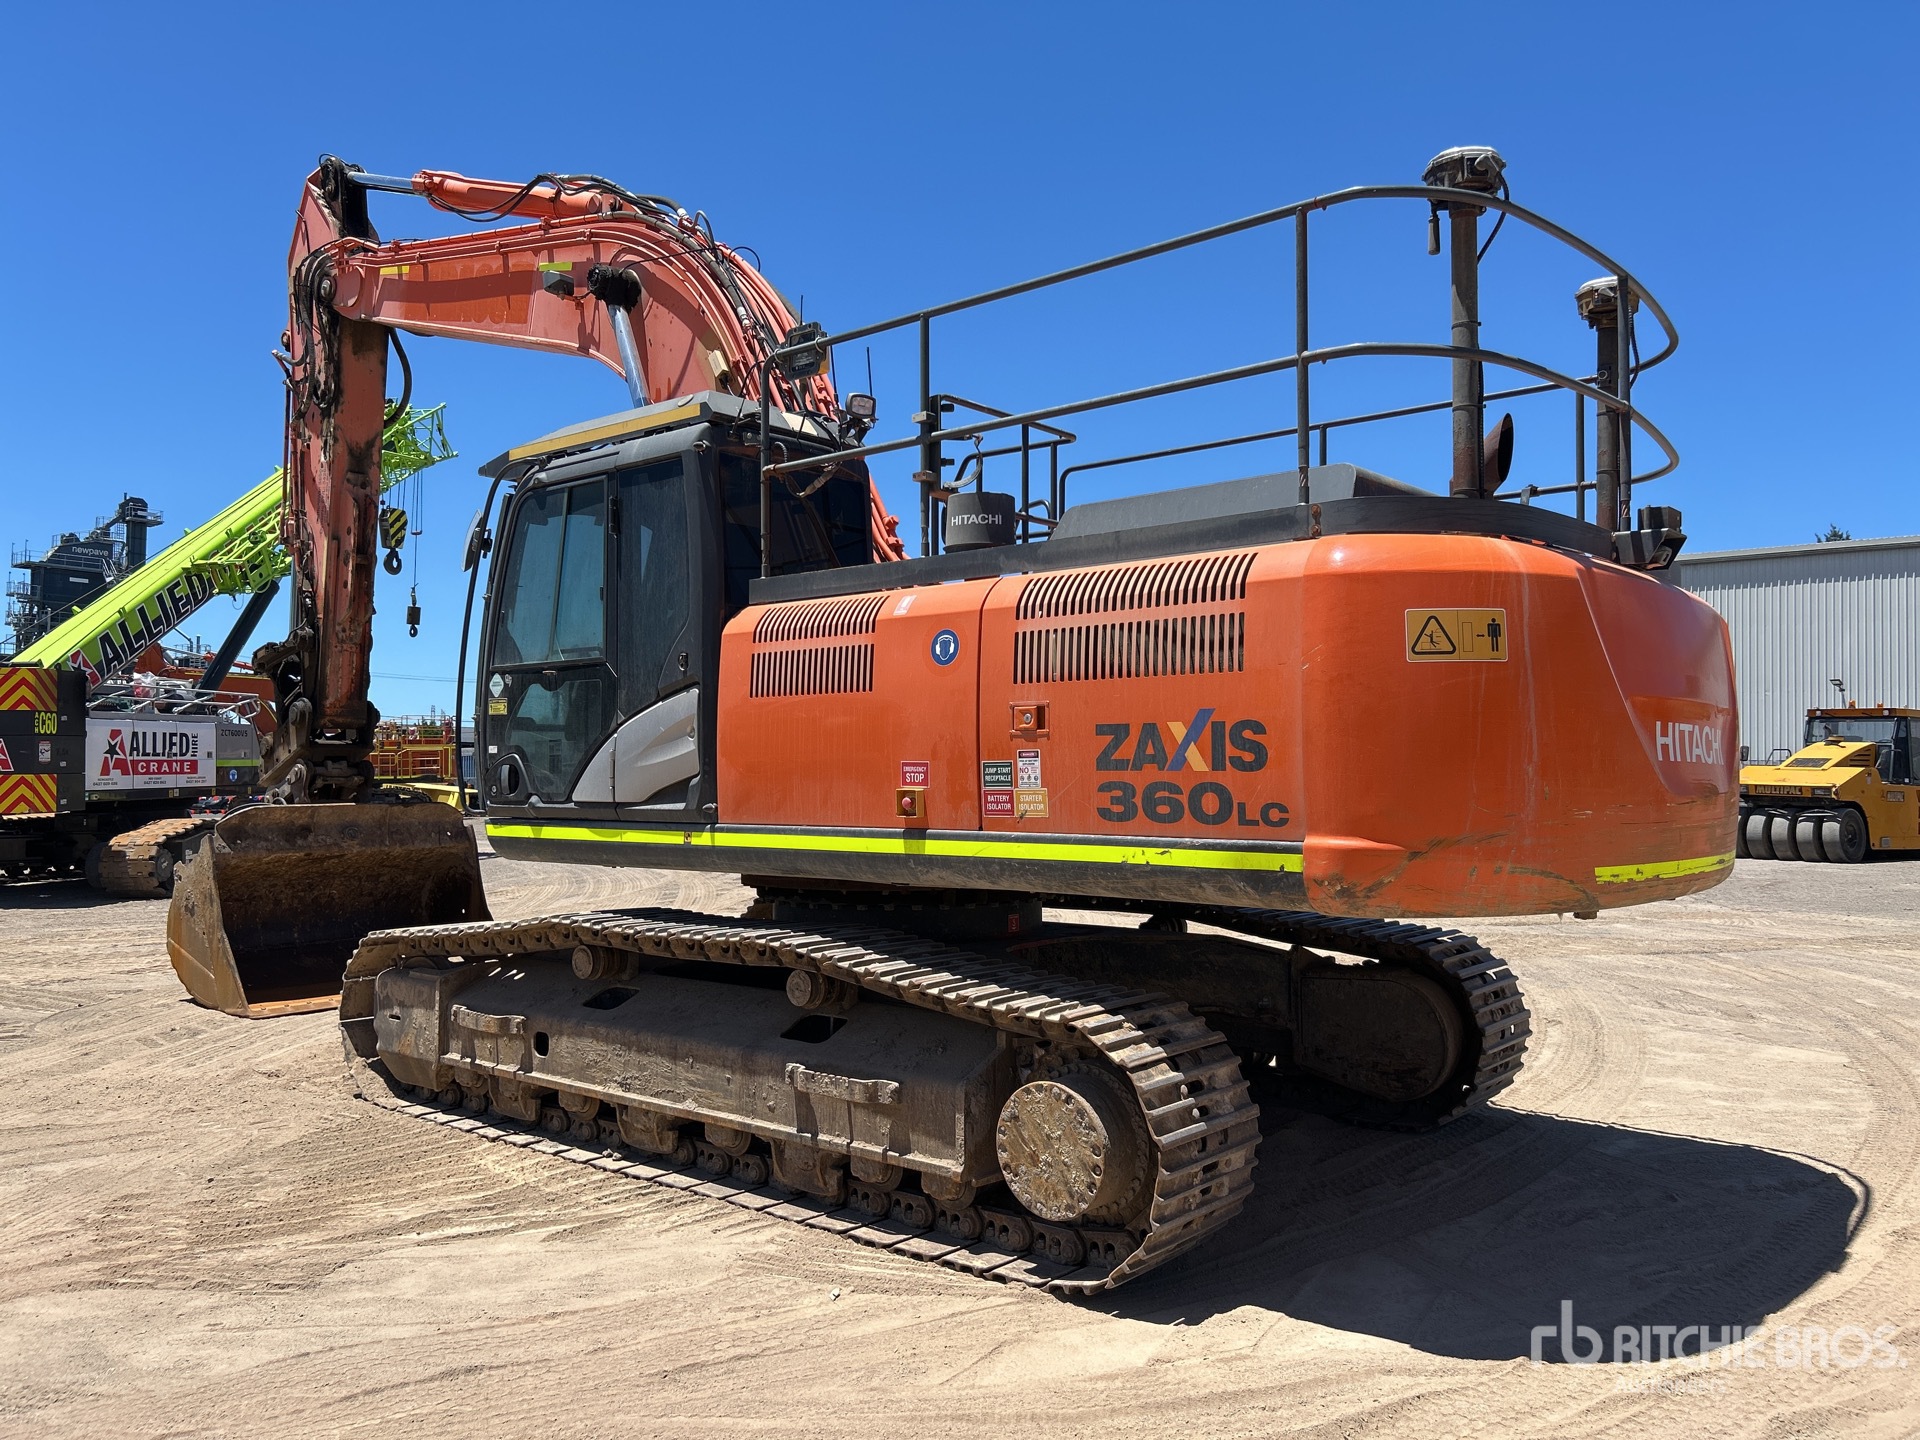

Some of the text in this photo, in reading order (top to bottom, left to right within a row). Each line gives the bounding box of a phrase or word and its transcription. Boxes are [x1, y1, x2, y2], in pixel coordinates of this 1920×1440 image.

[951, 512, 1002, 526] HITACHI
[71, 546, 109, 557] newpave
[99, 571, 210, 677] ALLIED
[39, 711, 58, 735] C60
[129, 731, 190, 758] ALLIED
[191, 732, 199, 758] HIRE
[1095, 707, 1269, 773] ZAXIS
[1655, 720, 1725, 766] HITACHI
[138, 760, 192, 774] CRANE
[905, 772, 925, 783] STOP
[1755, 785, 1802, 795] MULTIPAC
[987, 794, 1010, 802] BATTERY
[1018, 803, 1045, 811] ISOLATOR
